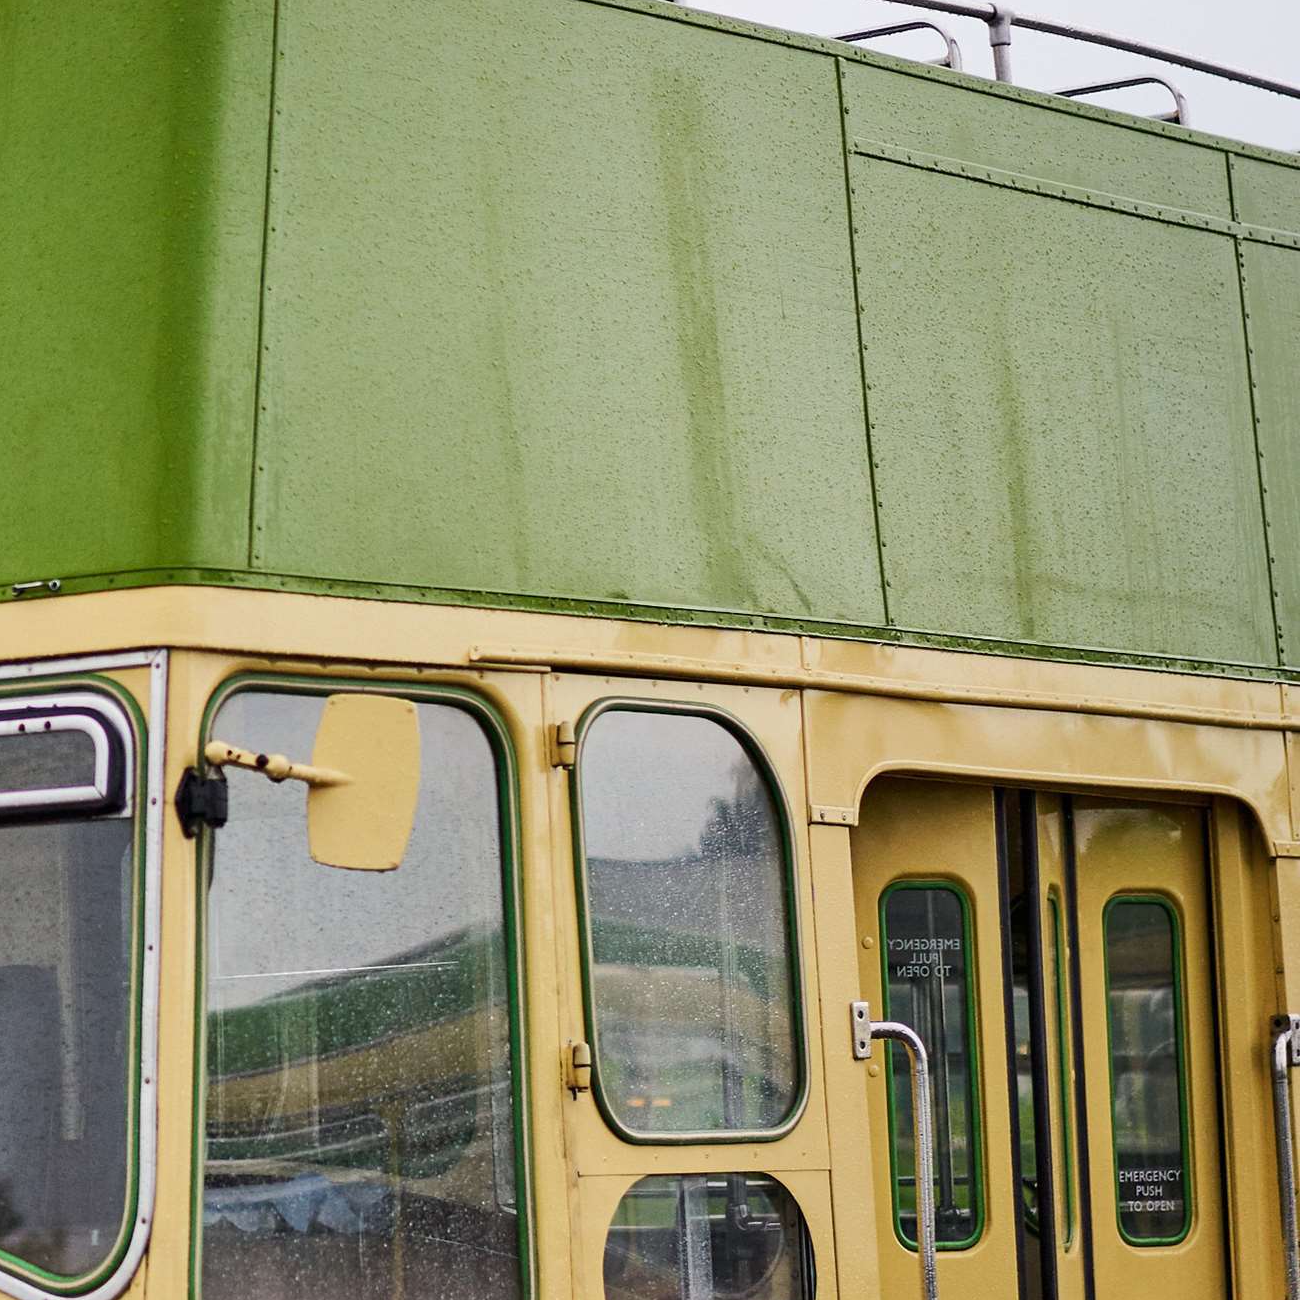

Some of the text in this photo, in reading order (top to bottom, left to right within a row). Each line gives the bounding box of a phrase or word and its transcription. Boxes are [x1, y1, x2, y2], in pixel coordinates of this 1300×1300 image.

[1119, 1169, 1181, 1182] EMERGENCY
[1135, 1185, 1164, 1197] PUSH
[1127, 1200, 1175, 1212] TO OPEN
